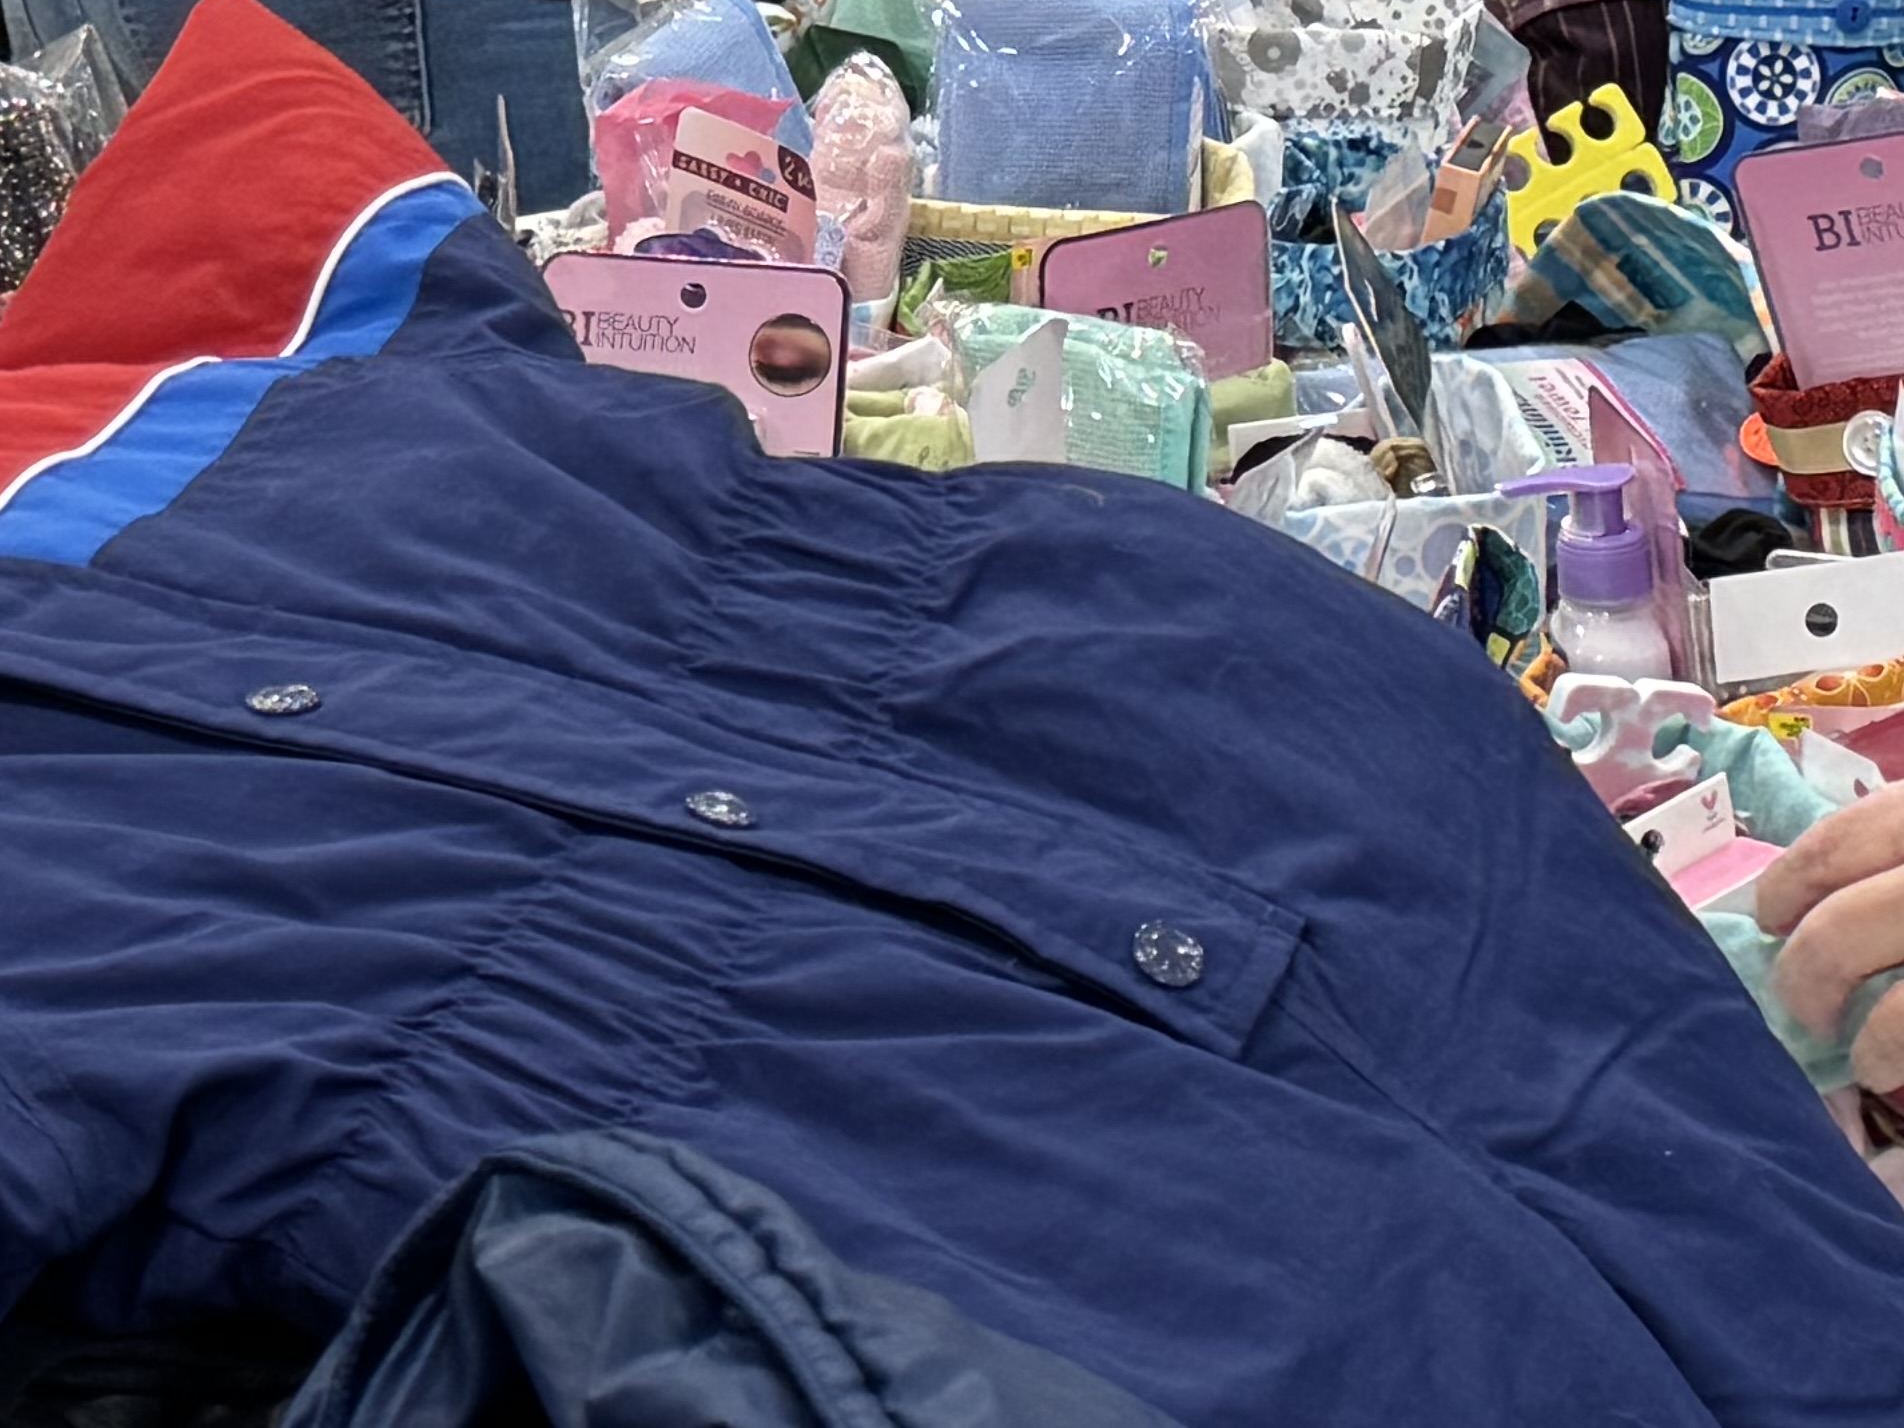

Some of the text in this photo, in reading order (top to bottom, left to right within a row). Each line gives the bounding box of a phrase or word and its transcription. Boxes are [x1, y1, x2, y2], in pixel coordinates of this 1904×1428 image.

[1807, 209, 1862, 251] BI
[1136, 287, 1205, 321] BEAUTY
[597, 311, 680, 337] BEAUTY
[596, 331, 696, 355] INTUITION
